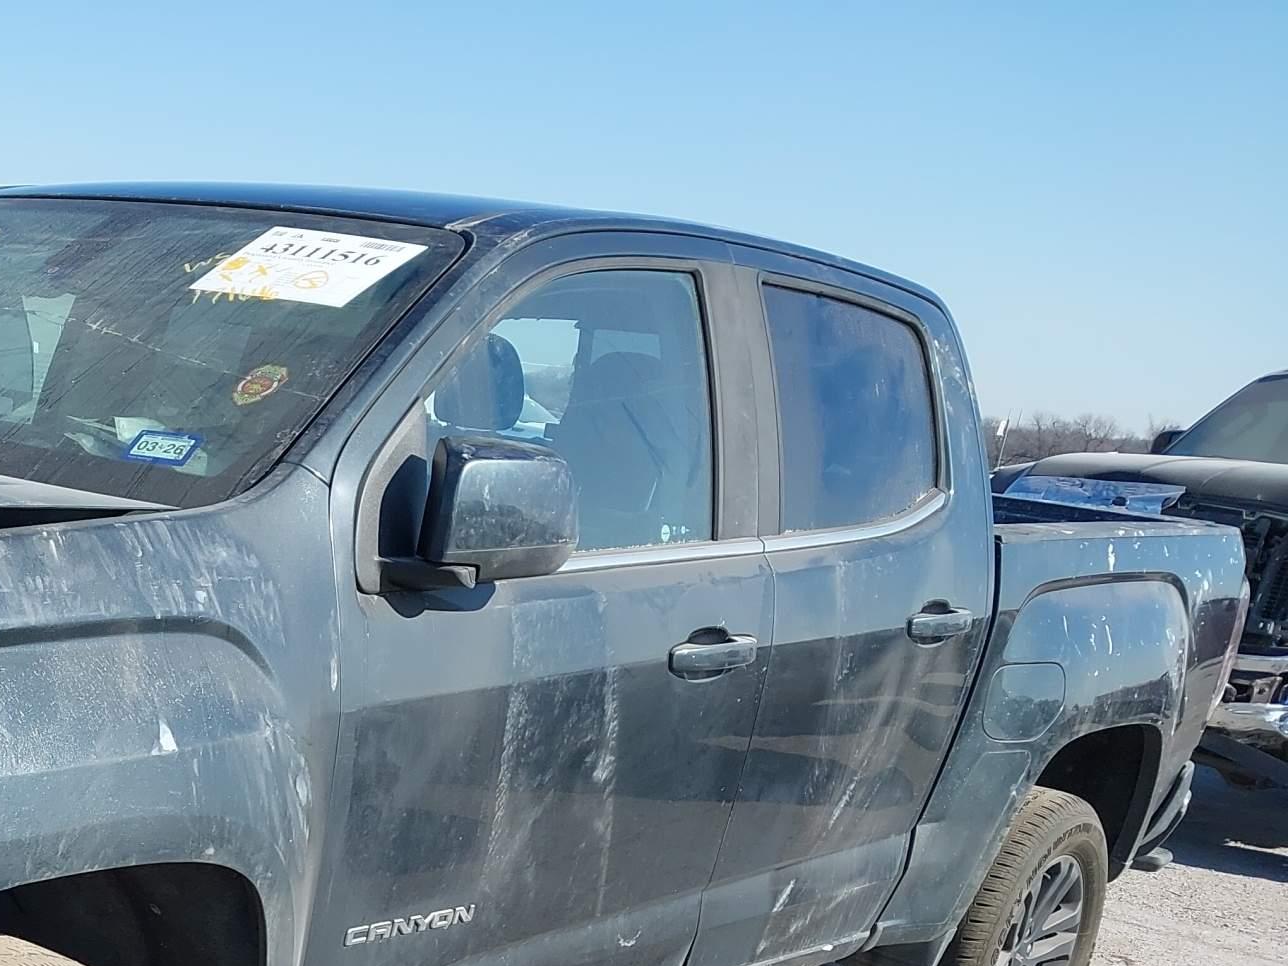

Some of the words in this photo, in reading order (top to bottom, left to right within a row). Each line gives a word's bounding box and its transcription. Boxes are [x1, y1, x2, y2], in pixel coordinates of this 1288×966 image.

[260, 242, 387, 267] 43111516
[137, 440, 159, 452] 03
[162, 443, 187, 455] 26
[343, 903, 475, 947] CANYON
